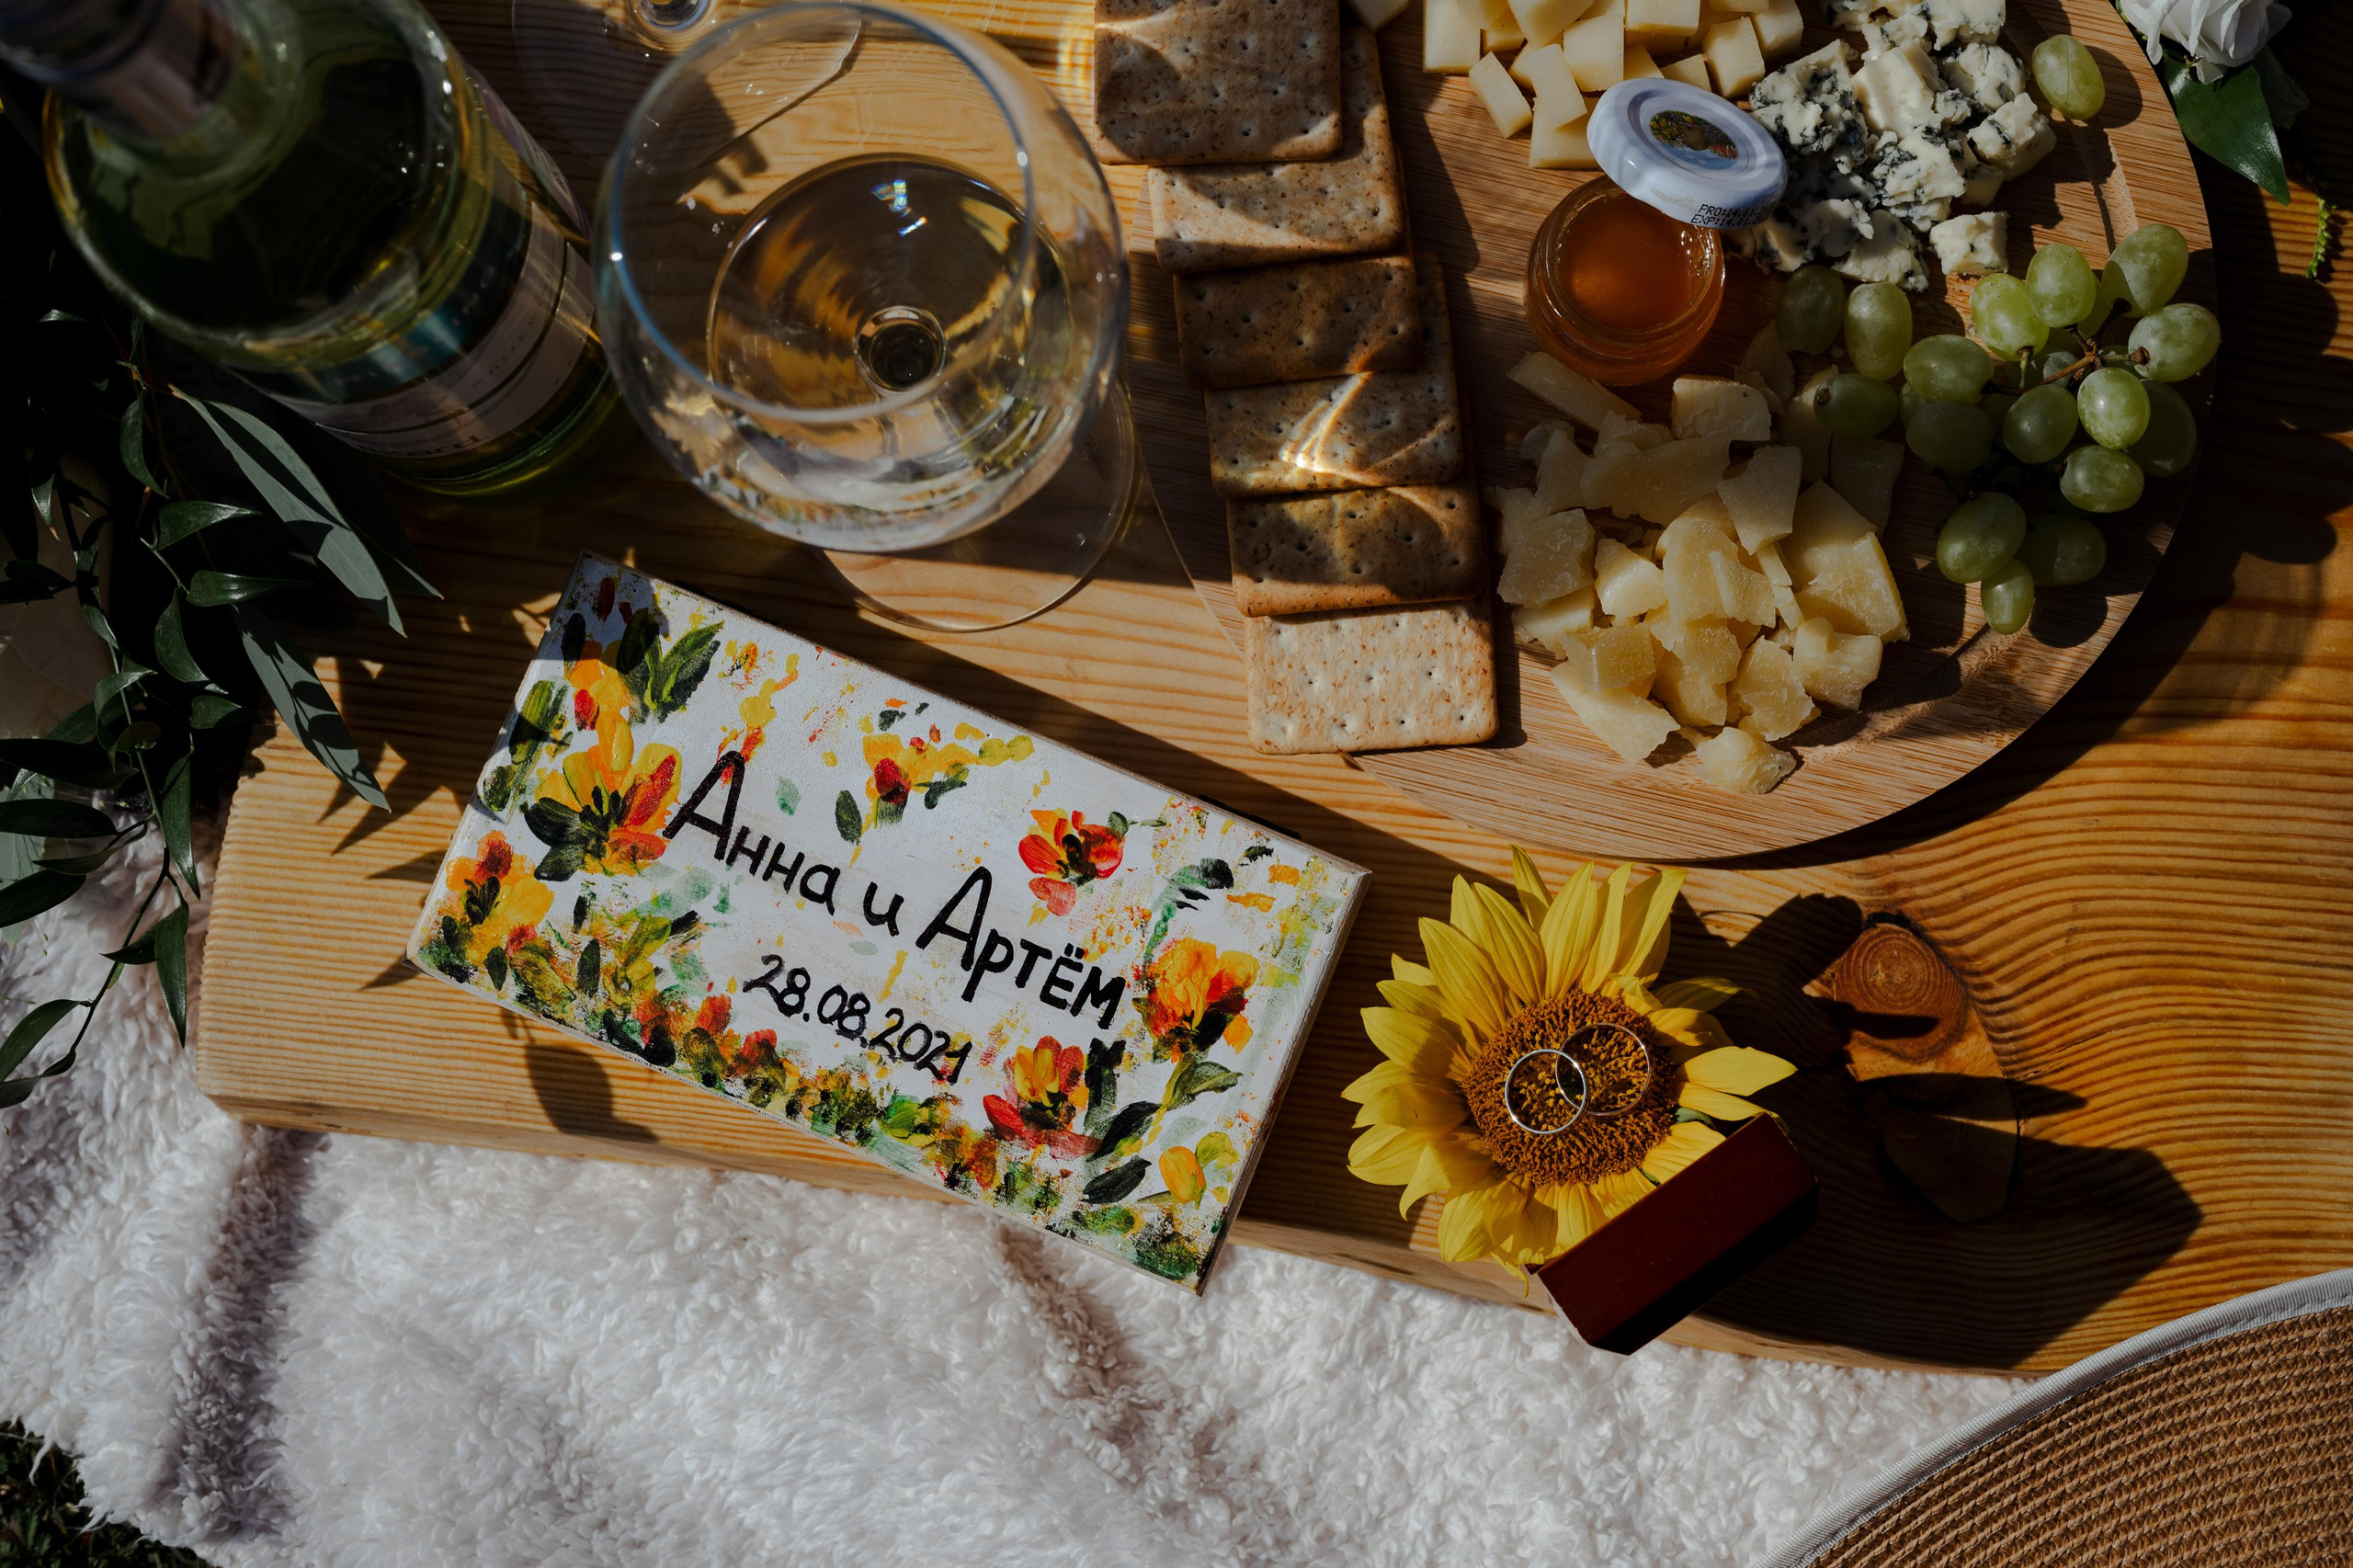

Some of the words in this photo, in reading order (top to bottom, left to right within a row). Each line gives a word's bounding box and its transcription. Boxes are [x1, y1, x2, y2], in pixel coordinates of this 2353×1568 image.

[662, 750, 840, 916] Анна
[862, 881, 905, 936] и
[743, 953, 972, 1084] 28.08.2021
